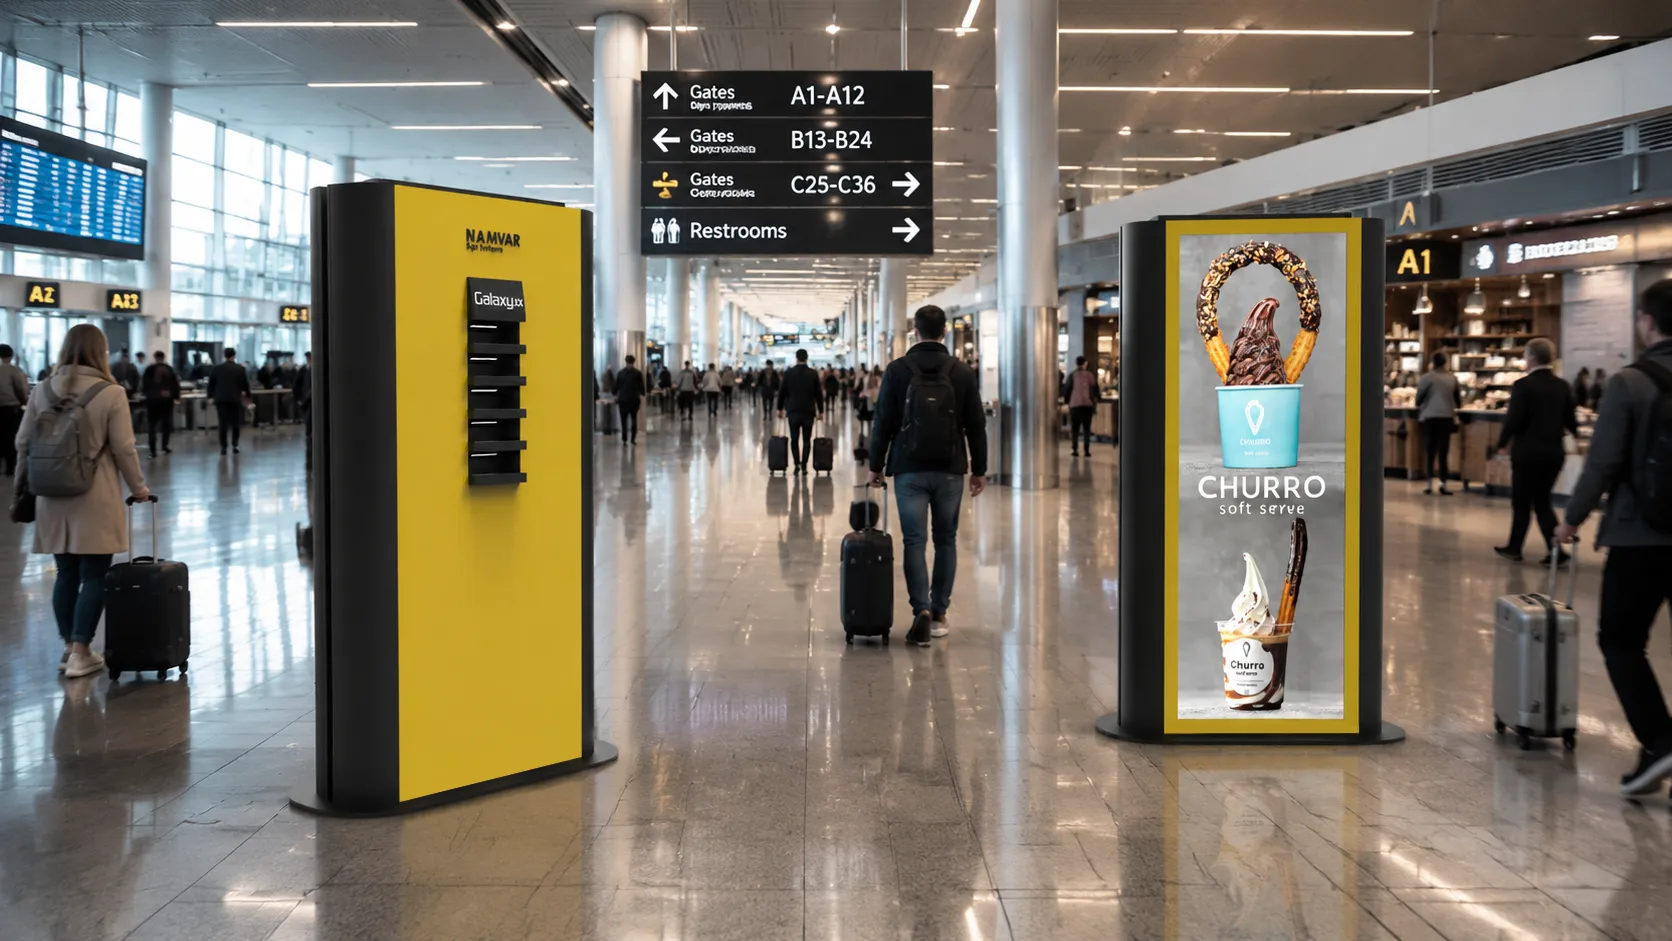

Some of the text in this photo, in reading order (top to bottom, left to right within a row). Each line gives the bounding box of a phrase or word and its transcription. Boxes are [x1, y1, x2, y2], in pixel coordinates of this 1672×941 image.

[690, 84, 866, 106] Gates A1-A12
[690, 128, 873, 150] Gates B13-B24
[690, 172, 876, 195] Gates C25-C36
[1399, 201, 1416, 227] A
[465, 228, 521, 248] NAMVAR
[690, 222, 788, 239] Restrooms
[1397, 248, 1431, 275] A1
[1198, 475, 1326, 499] CHURRO
[1219, 501, 1305, 515] soft serve
[1230, 660, 1265, 670] Churro
